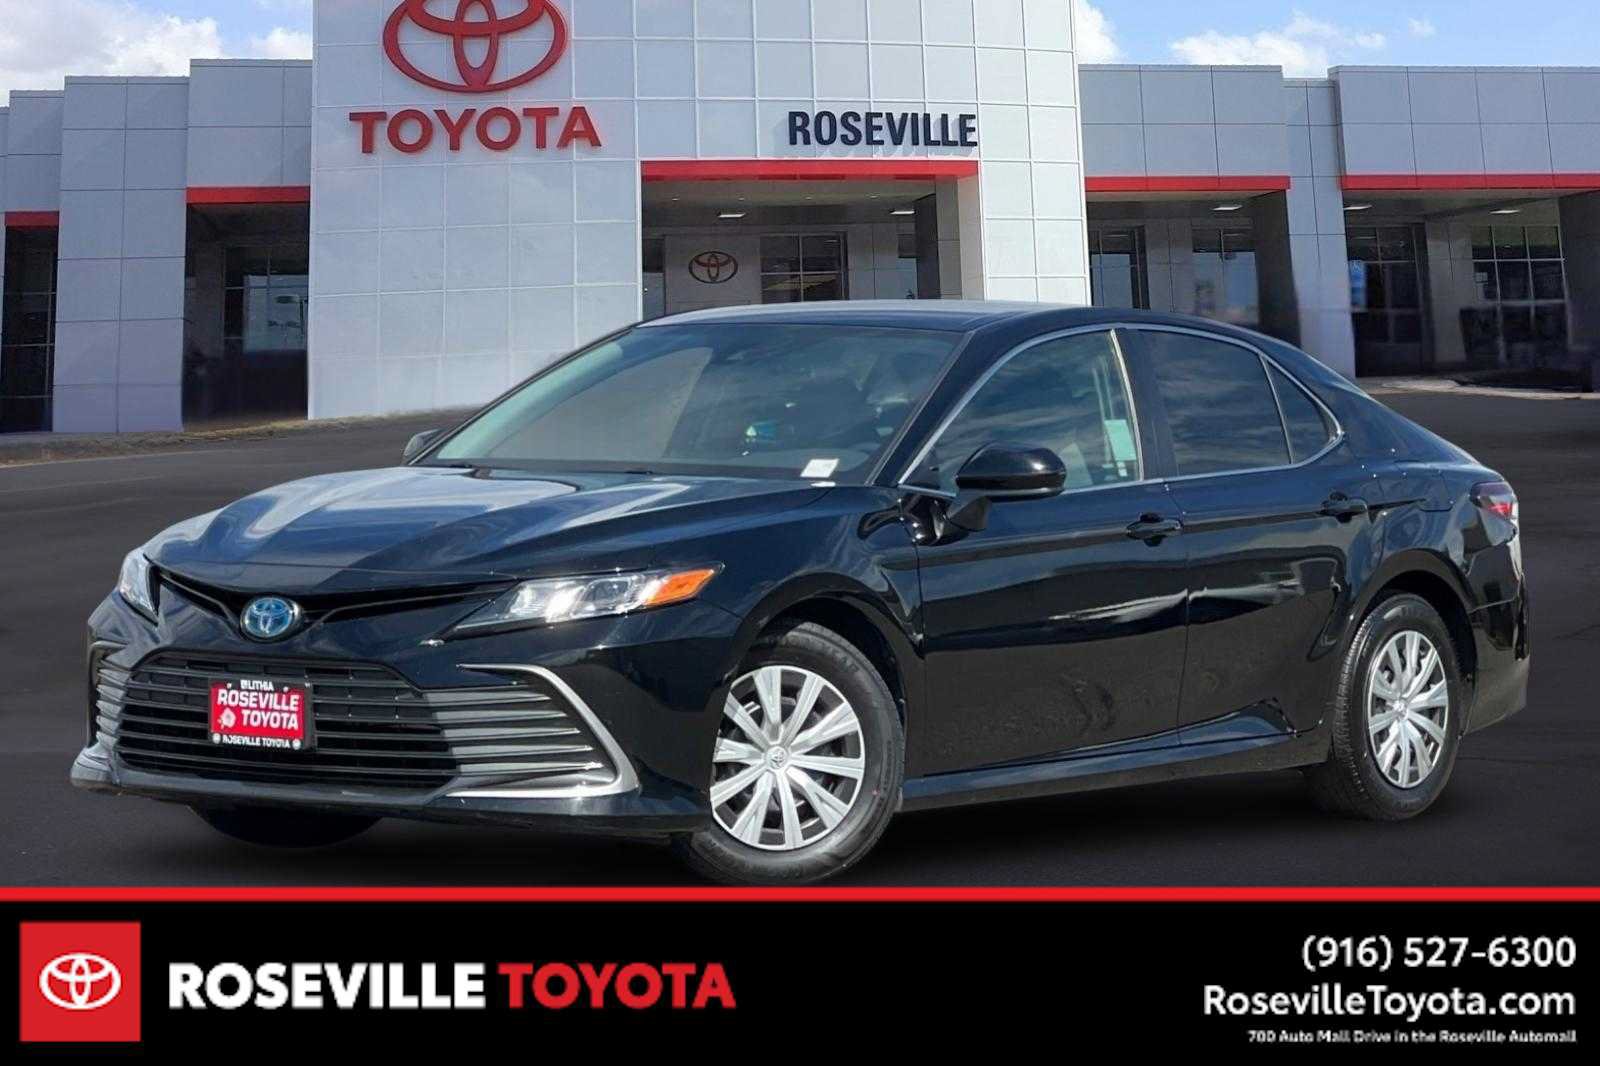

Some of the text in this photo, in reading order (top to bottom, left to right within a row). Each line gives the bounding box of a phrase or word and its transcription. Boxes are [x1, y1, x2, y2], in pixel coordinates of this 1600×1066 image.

[349, 106, 602, 154] TOYOTA
[788, 110, 978, 147] ROSEVILLE
[249, 680, 274, 691] LITHIA
[217, 689, 299, 711] ROSEVILLE
[241, 709, 299, 730] TOYOTA
[262, 737, 290, 748] TOYOTA
